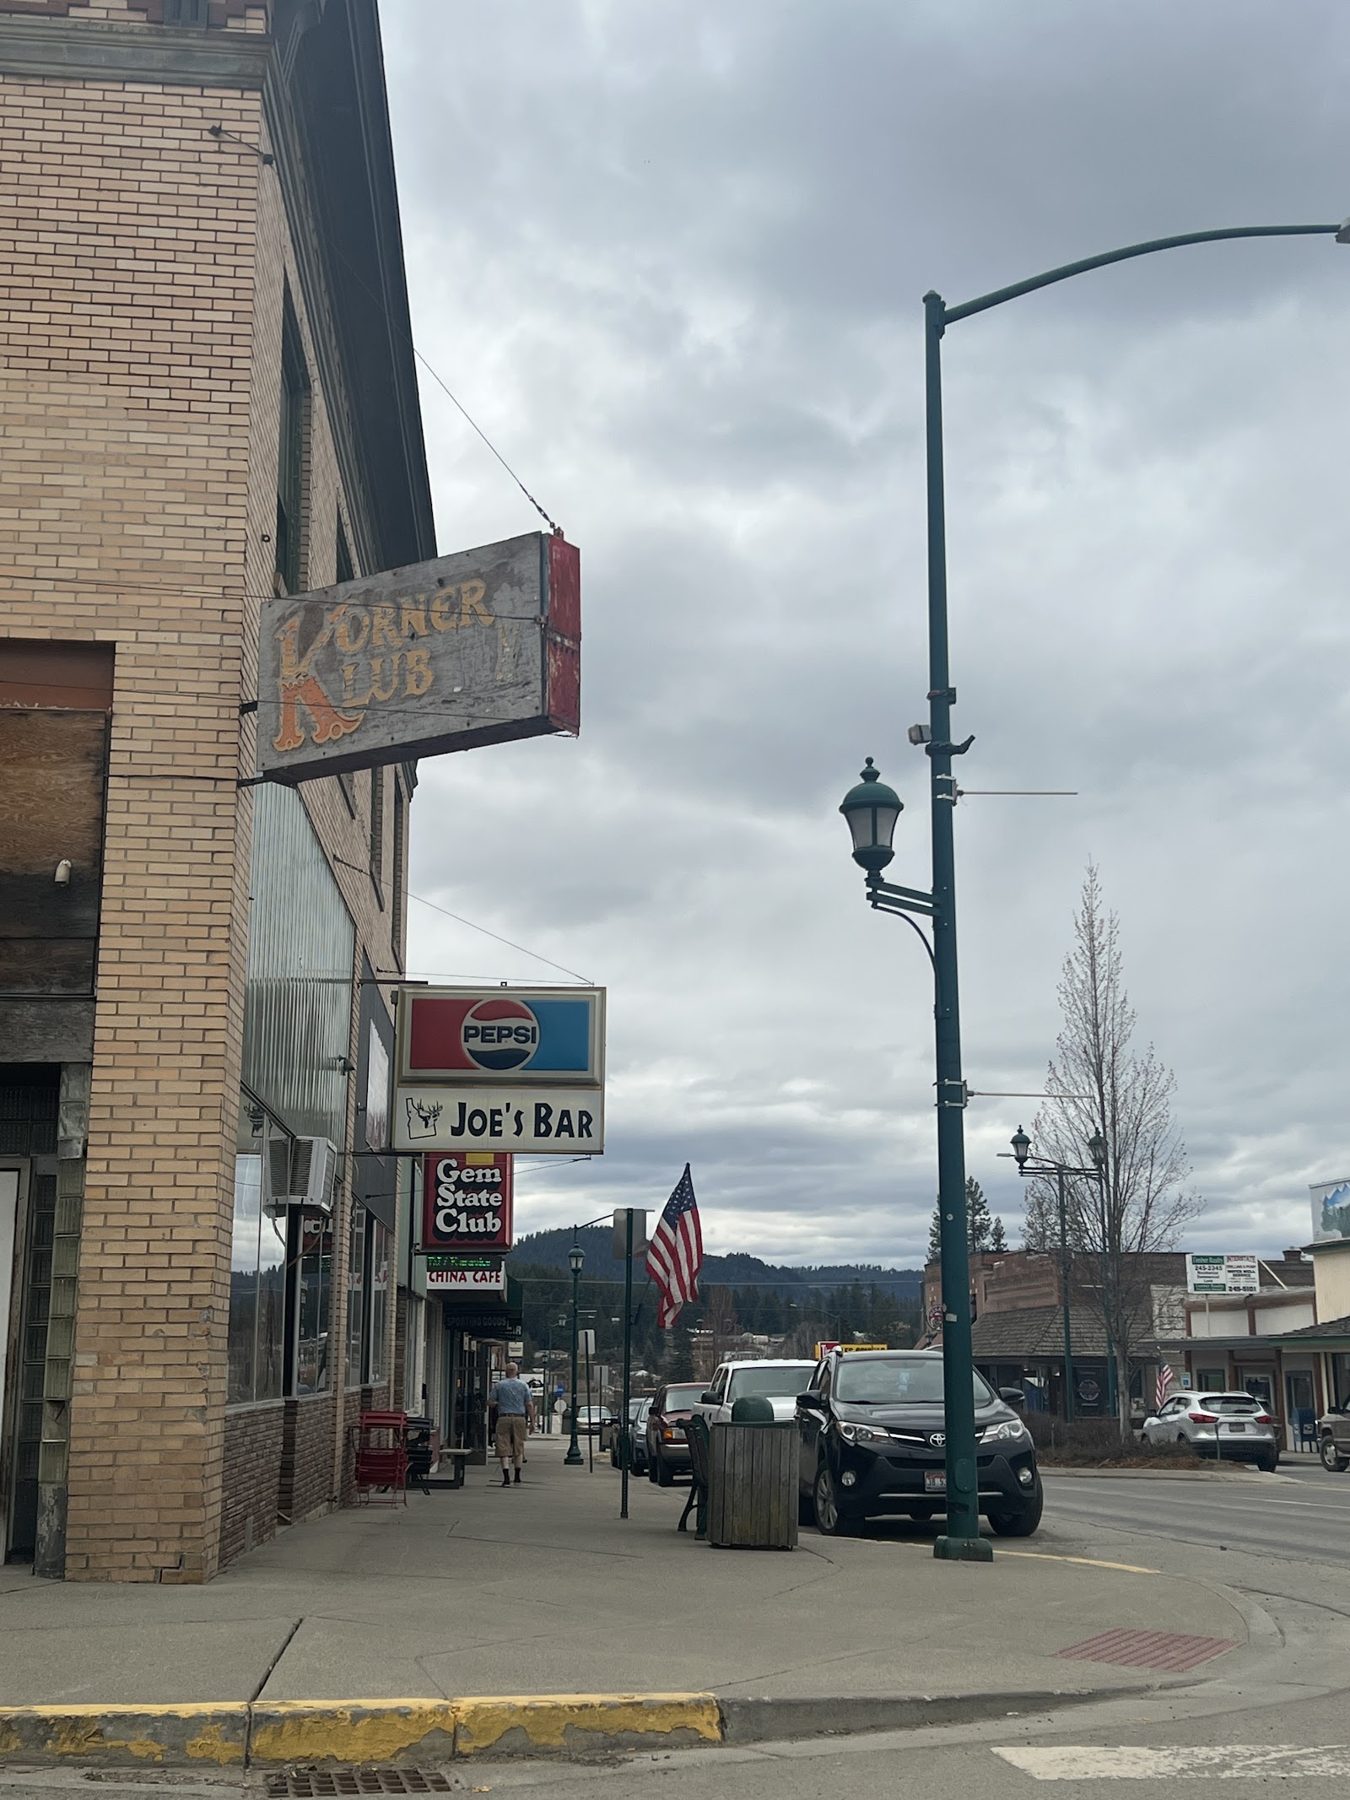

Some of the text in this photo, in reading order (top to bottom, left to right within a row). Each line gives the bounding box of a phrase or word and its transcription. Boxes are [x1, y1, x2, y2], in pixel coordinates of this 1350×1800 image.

[463, 1025, 537, 1044] PEPSI
[450, 1102, 593, 1138] JOE'S BAR
[436, 1158, 502, 1184] Gem
[436, 1184, 503, 1208] State
[435, 1208, 502, 1233] Club
[428, 1271, 501, 1283] CHINA CAFE
